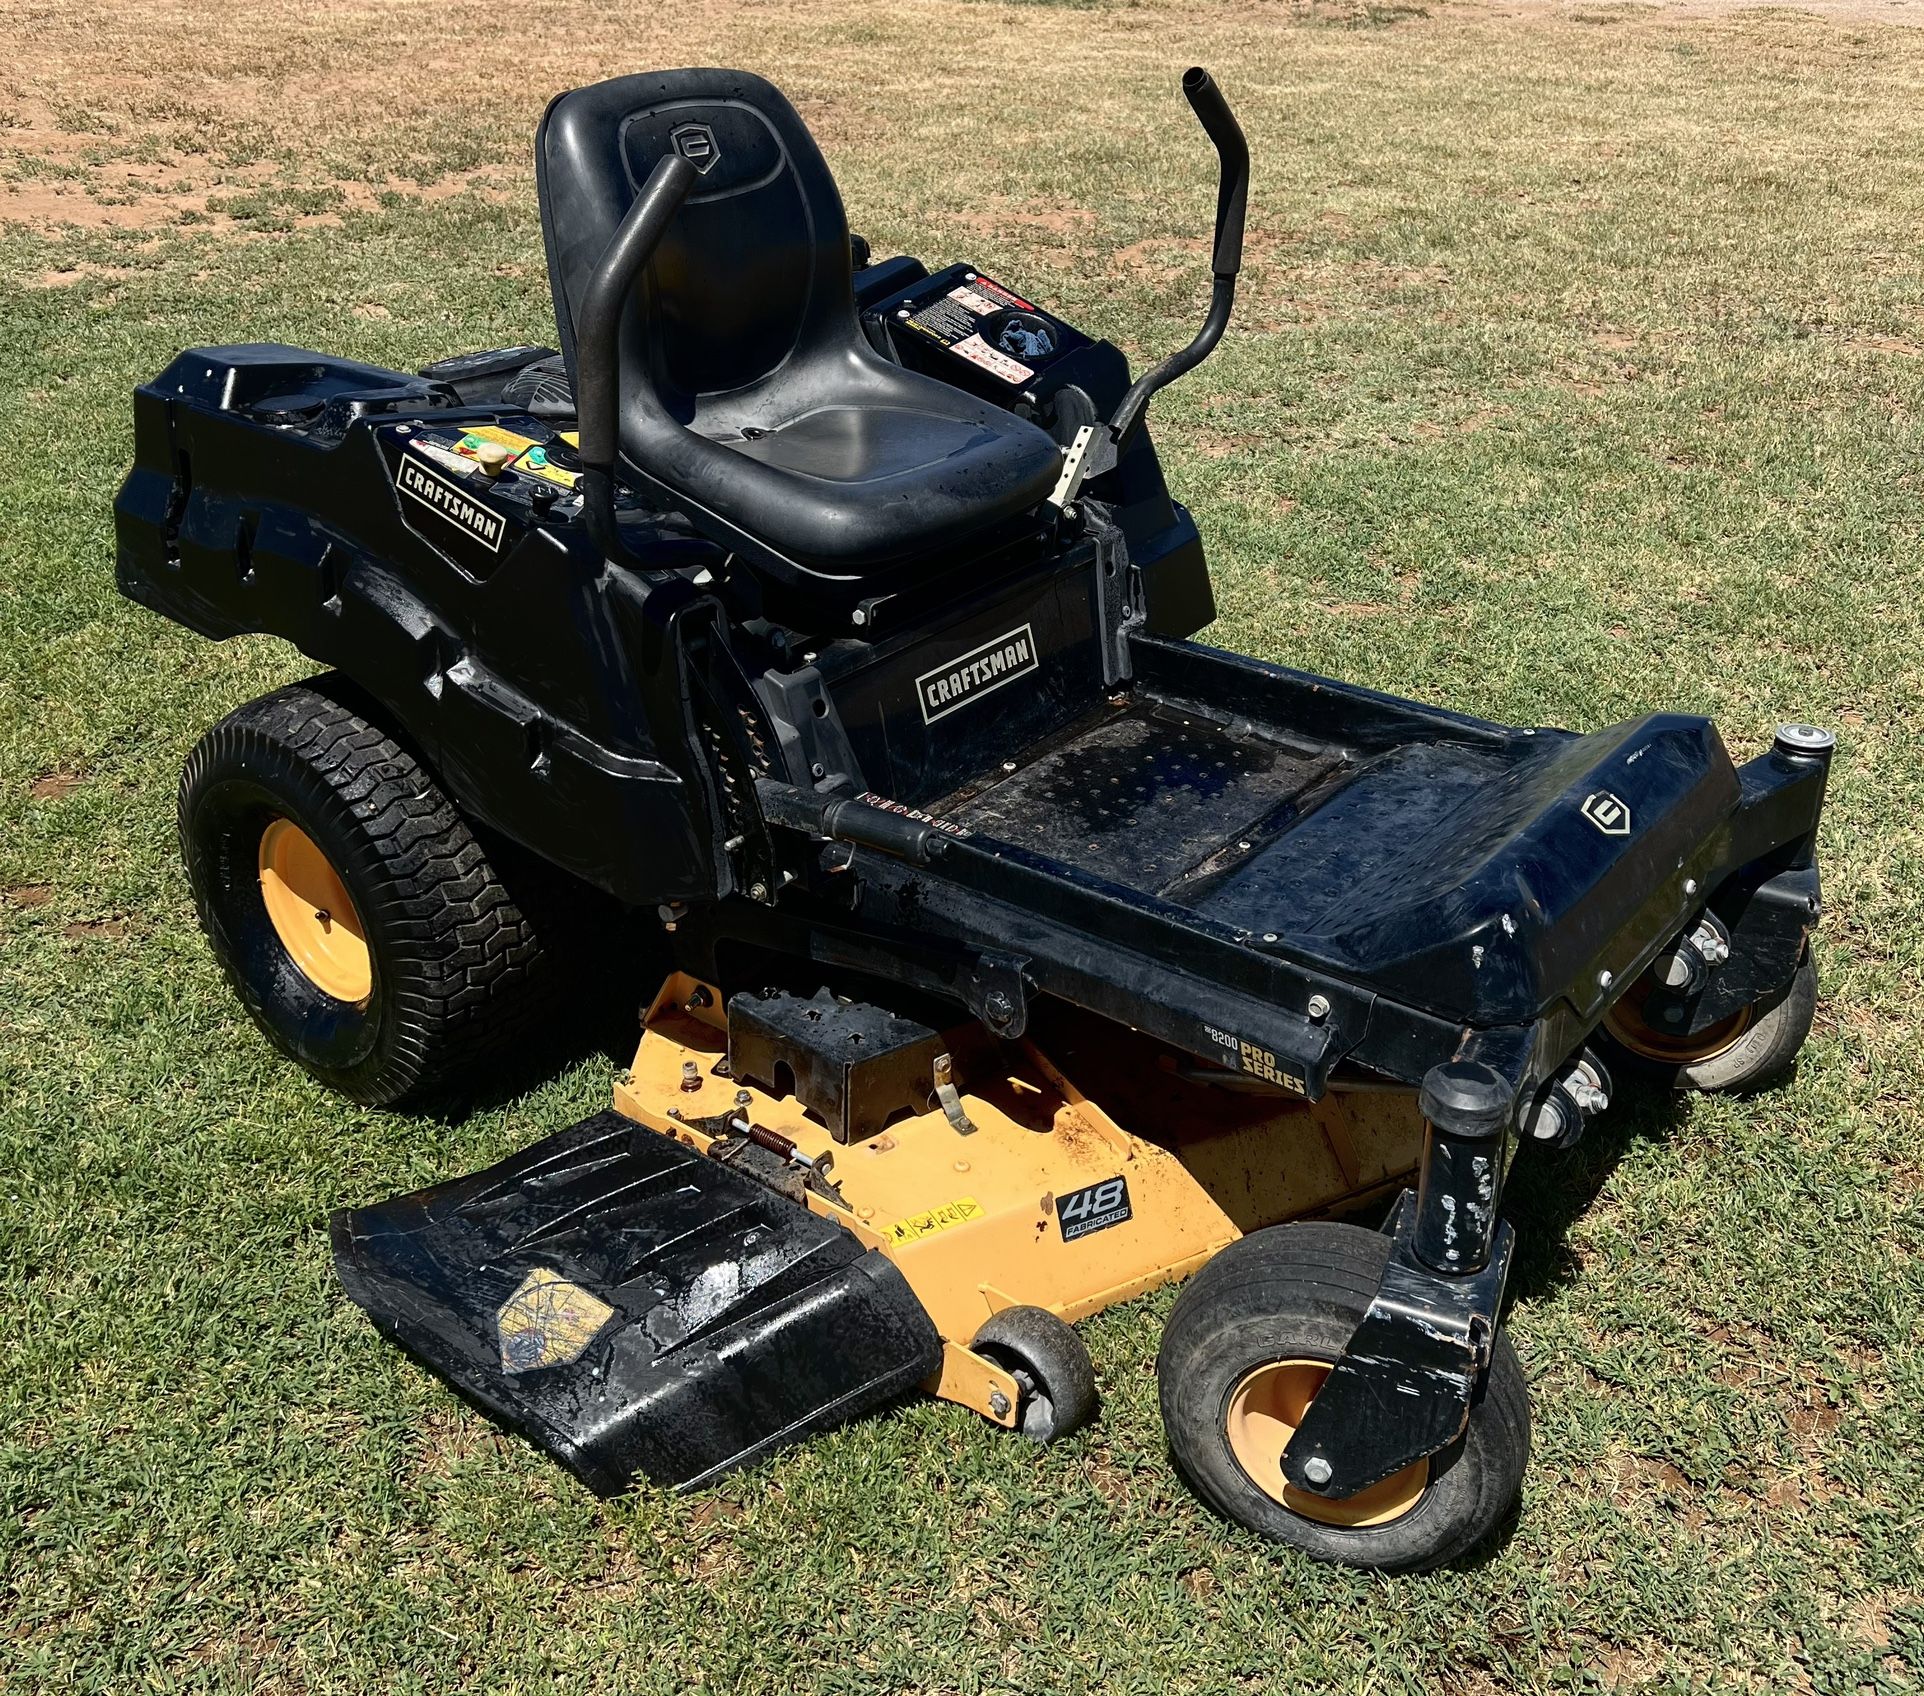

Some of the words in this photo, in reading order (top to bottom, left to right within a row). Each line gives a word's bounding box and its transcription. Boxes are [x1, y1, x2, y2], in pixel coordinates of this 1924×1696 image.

[405, 467, 497, 540] CRAFTSMAN
[926, 638, 1029, 708] CRAFTSMAN
[1211, 1028, 1238, 1051] 8200
[1240, 1041, 1276, 1068] PRO
[1242, 1055, 1306, 1095] SERIES
[1062, 1179, 1125, 1220] 48
[1067, 1208, 1127, 1236] FABRICATED
[1257, 1331, 1348, 1353] CARL
